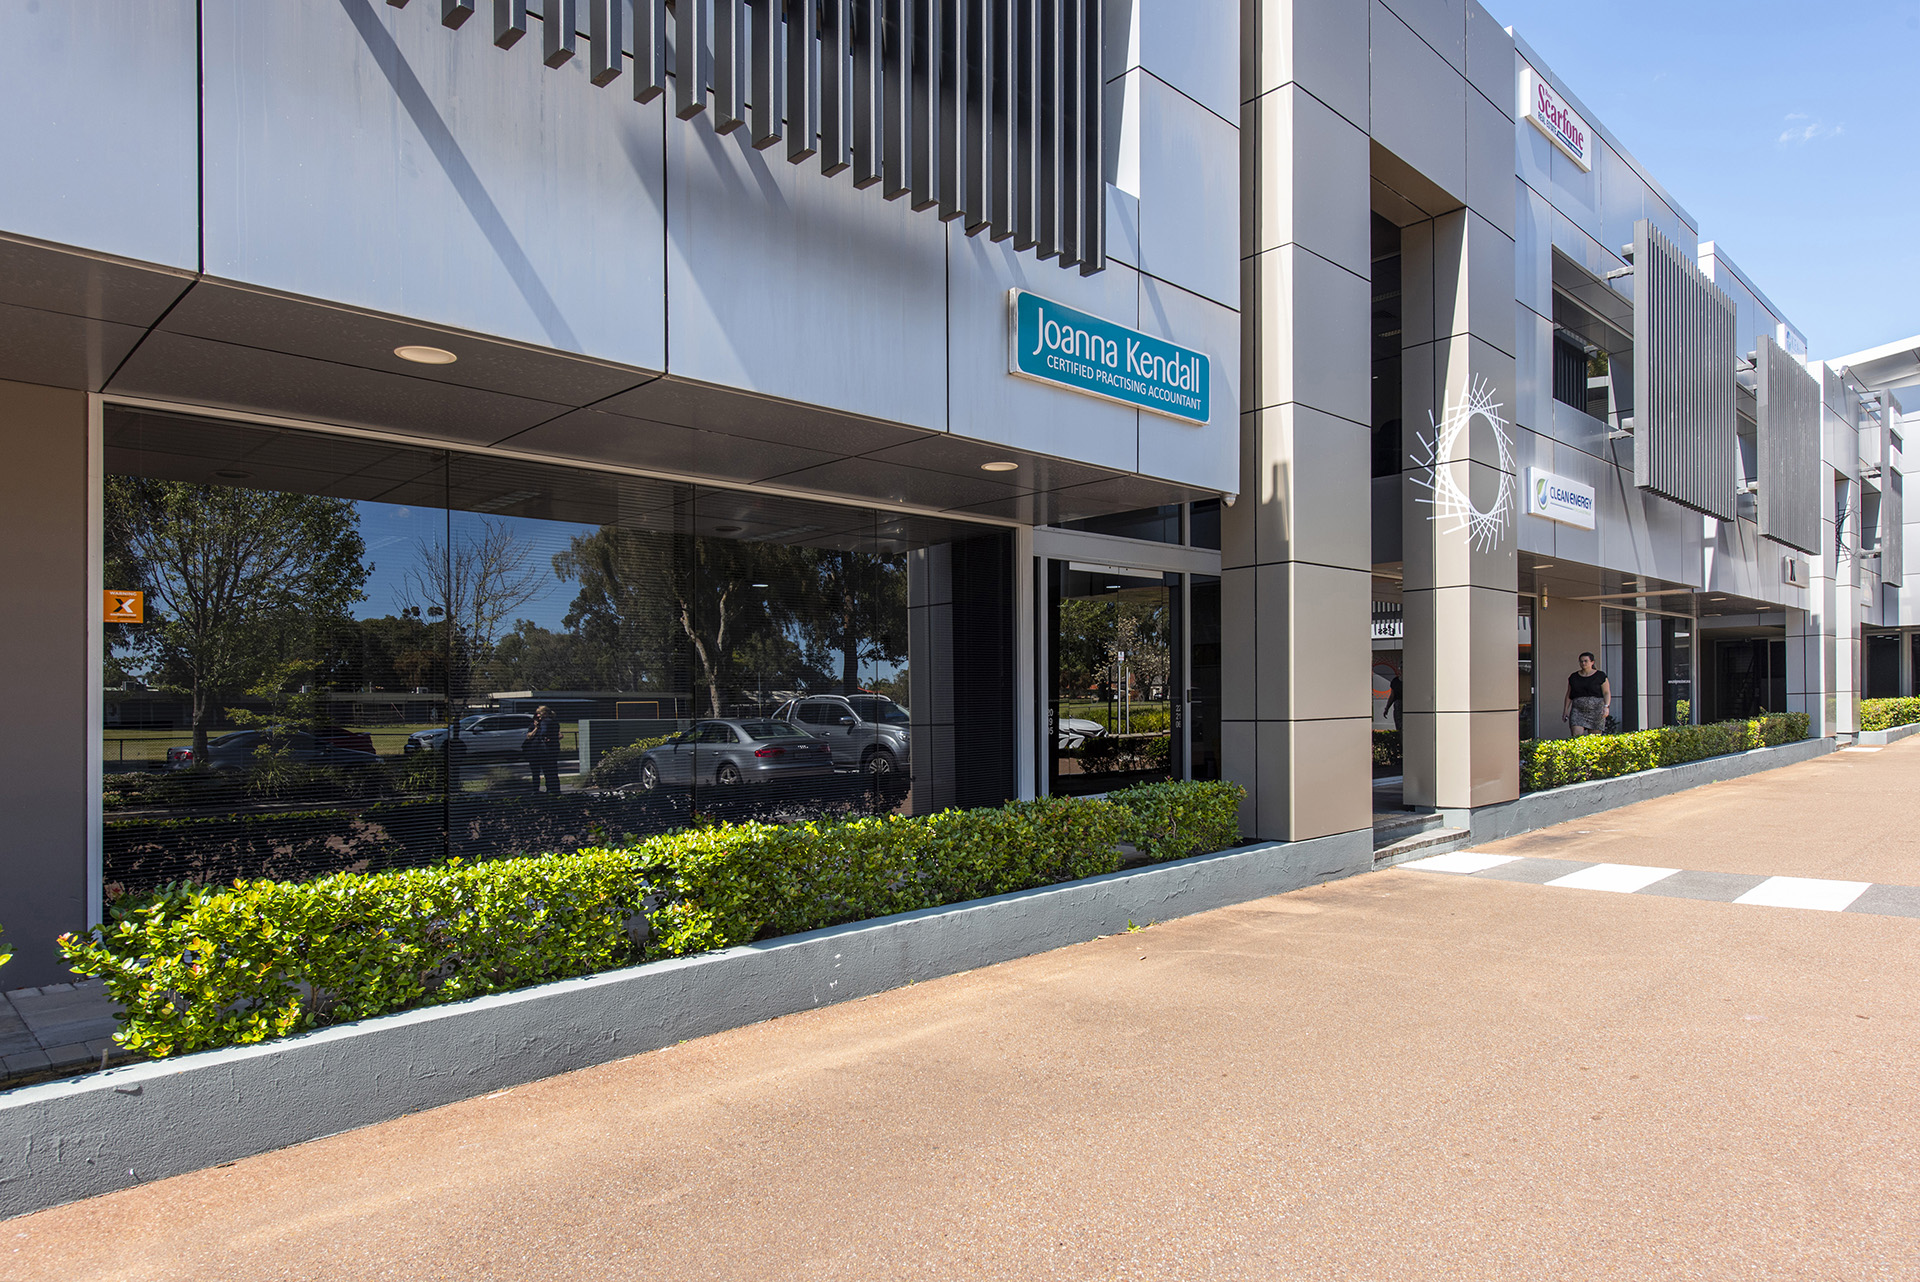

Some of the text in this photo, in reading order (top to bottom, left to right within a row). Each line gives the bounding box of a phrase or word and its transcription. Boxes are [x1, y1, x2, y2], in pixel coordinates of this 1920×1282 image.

[1538, 83, 1584, 151] Scarfone
[1032, 307, 1200, 394] Joanna Kendall
[1046, 354, 1202, 411] CERTIFIED PRACTISING ACCOUNTANT
